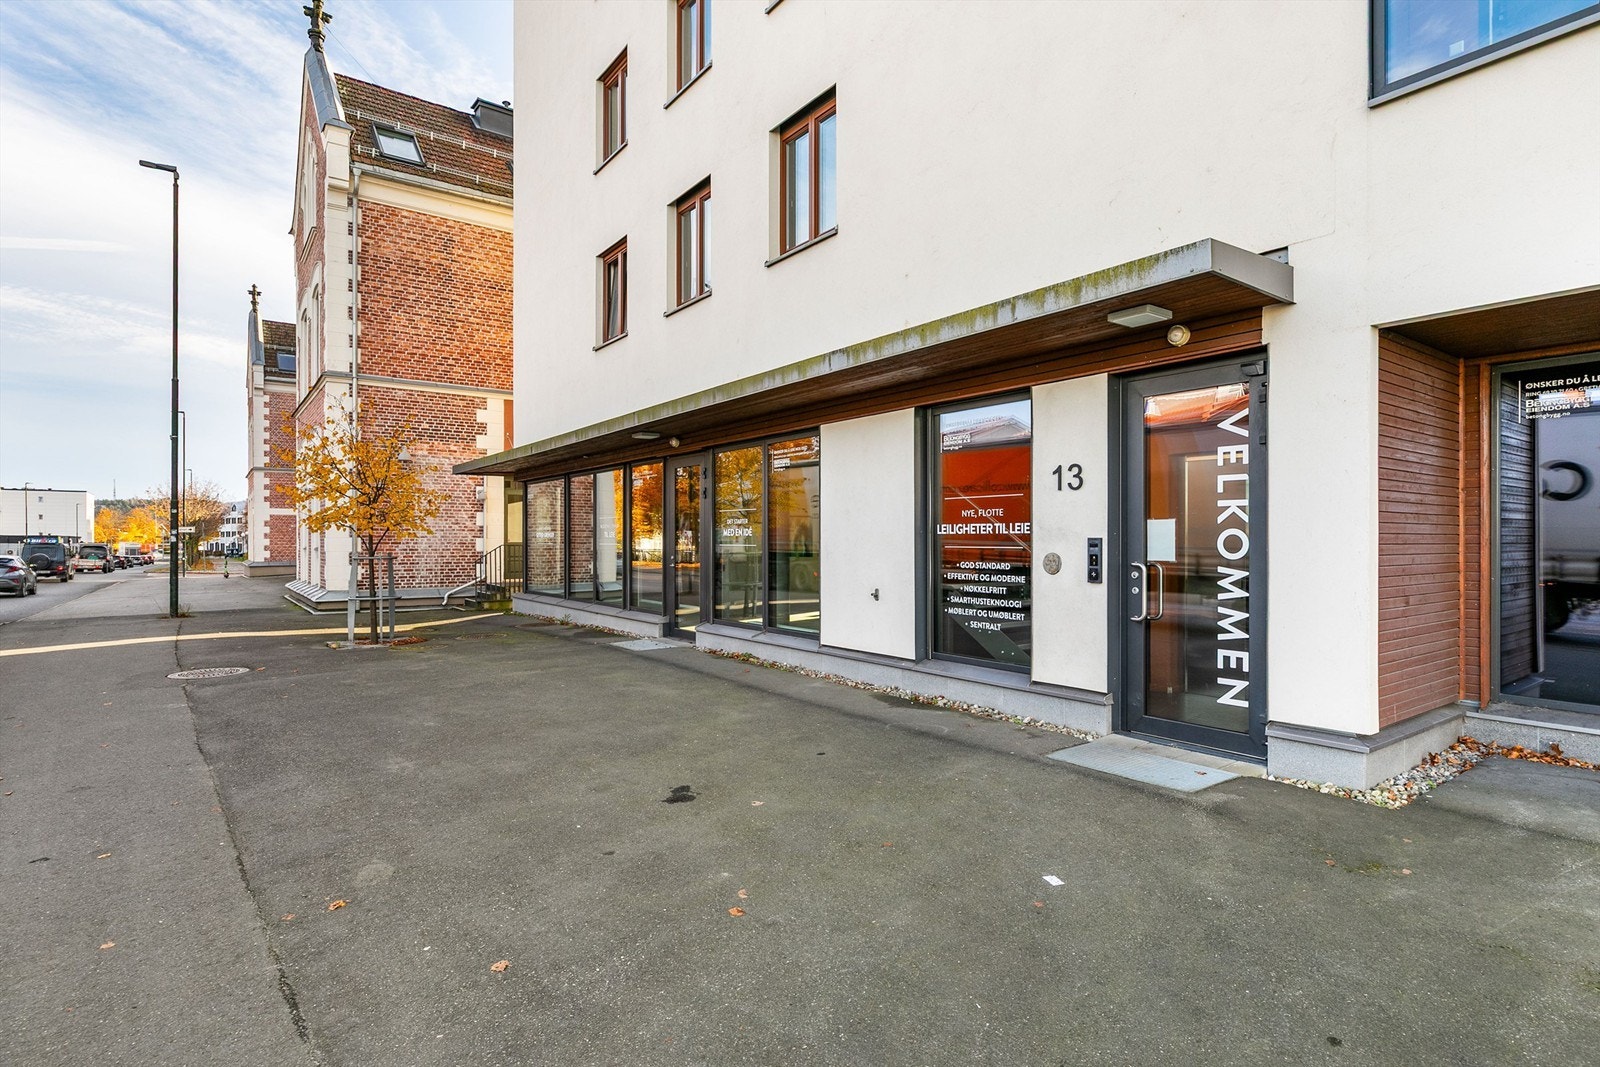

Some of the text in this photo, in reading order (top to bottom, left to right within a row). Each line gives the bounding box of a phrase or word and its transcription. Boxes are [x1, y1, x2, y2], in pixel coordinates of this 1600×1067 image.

[1525, 380, 1564, 389] ØNSKER
[1566, 377, 1580, 385] DU
[1582, 374, 1590, 383] Å
[1052, 463, 1084, 491] 13
[961, 508, 1004, 518] NYE, FLOTTE
[723, 528, 735, 536] MED
[735, 528, 743, 536] EN
[936, 522, 1031, 535] LEILIGHETER TIL LEIE
[1217, 408, 1249, 708] VELKOMMEN
[960, 561, 1011, 570] GOD STANDARD
[947, 572, 1026, 584] EFFEKTIVE OG MODERNE
[963, 585, 1007, 595] NØKKELFRITT
[950, 595, 1022, 608] SMARTHUSTEKNOLOGI
[947, 607, 1026, 621] MØBLERT OG UMØBLERT
[969, 620, 1002, 631] SENTRALT
